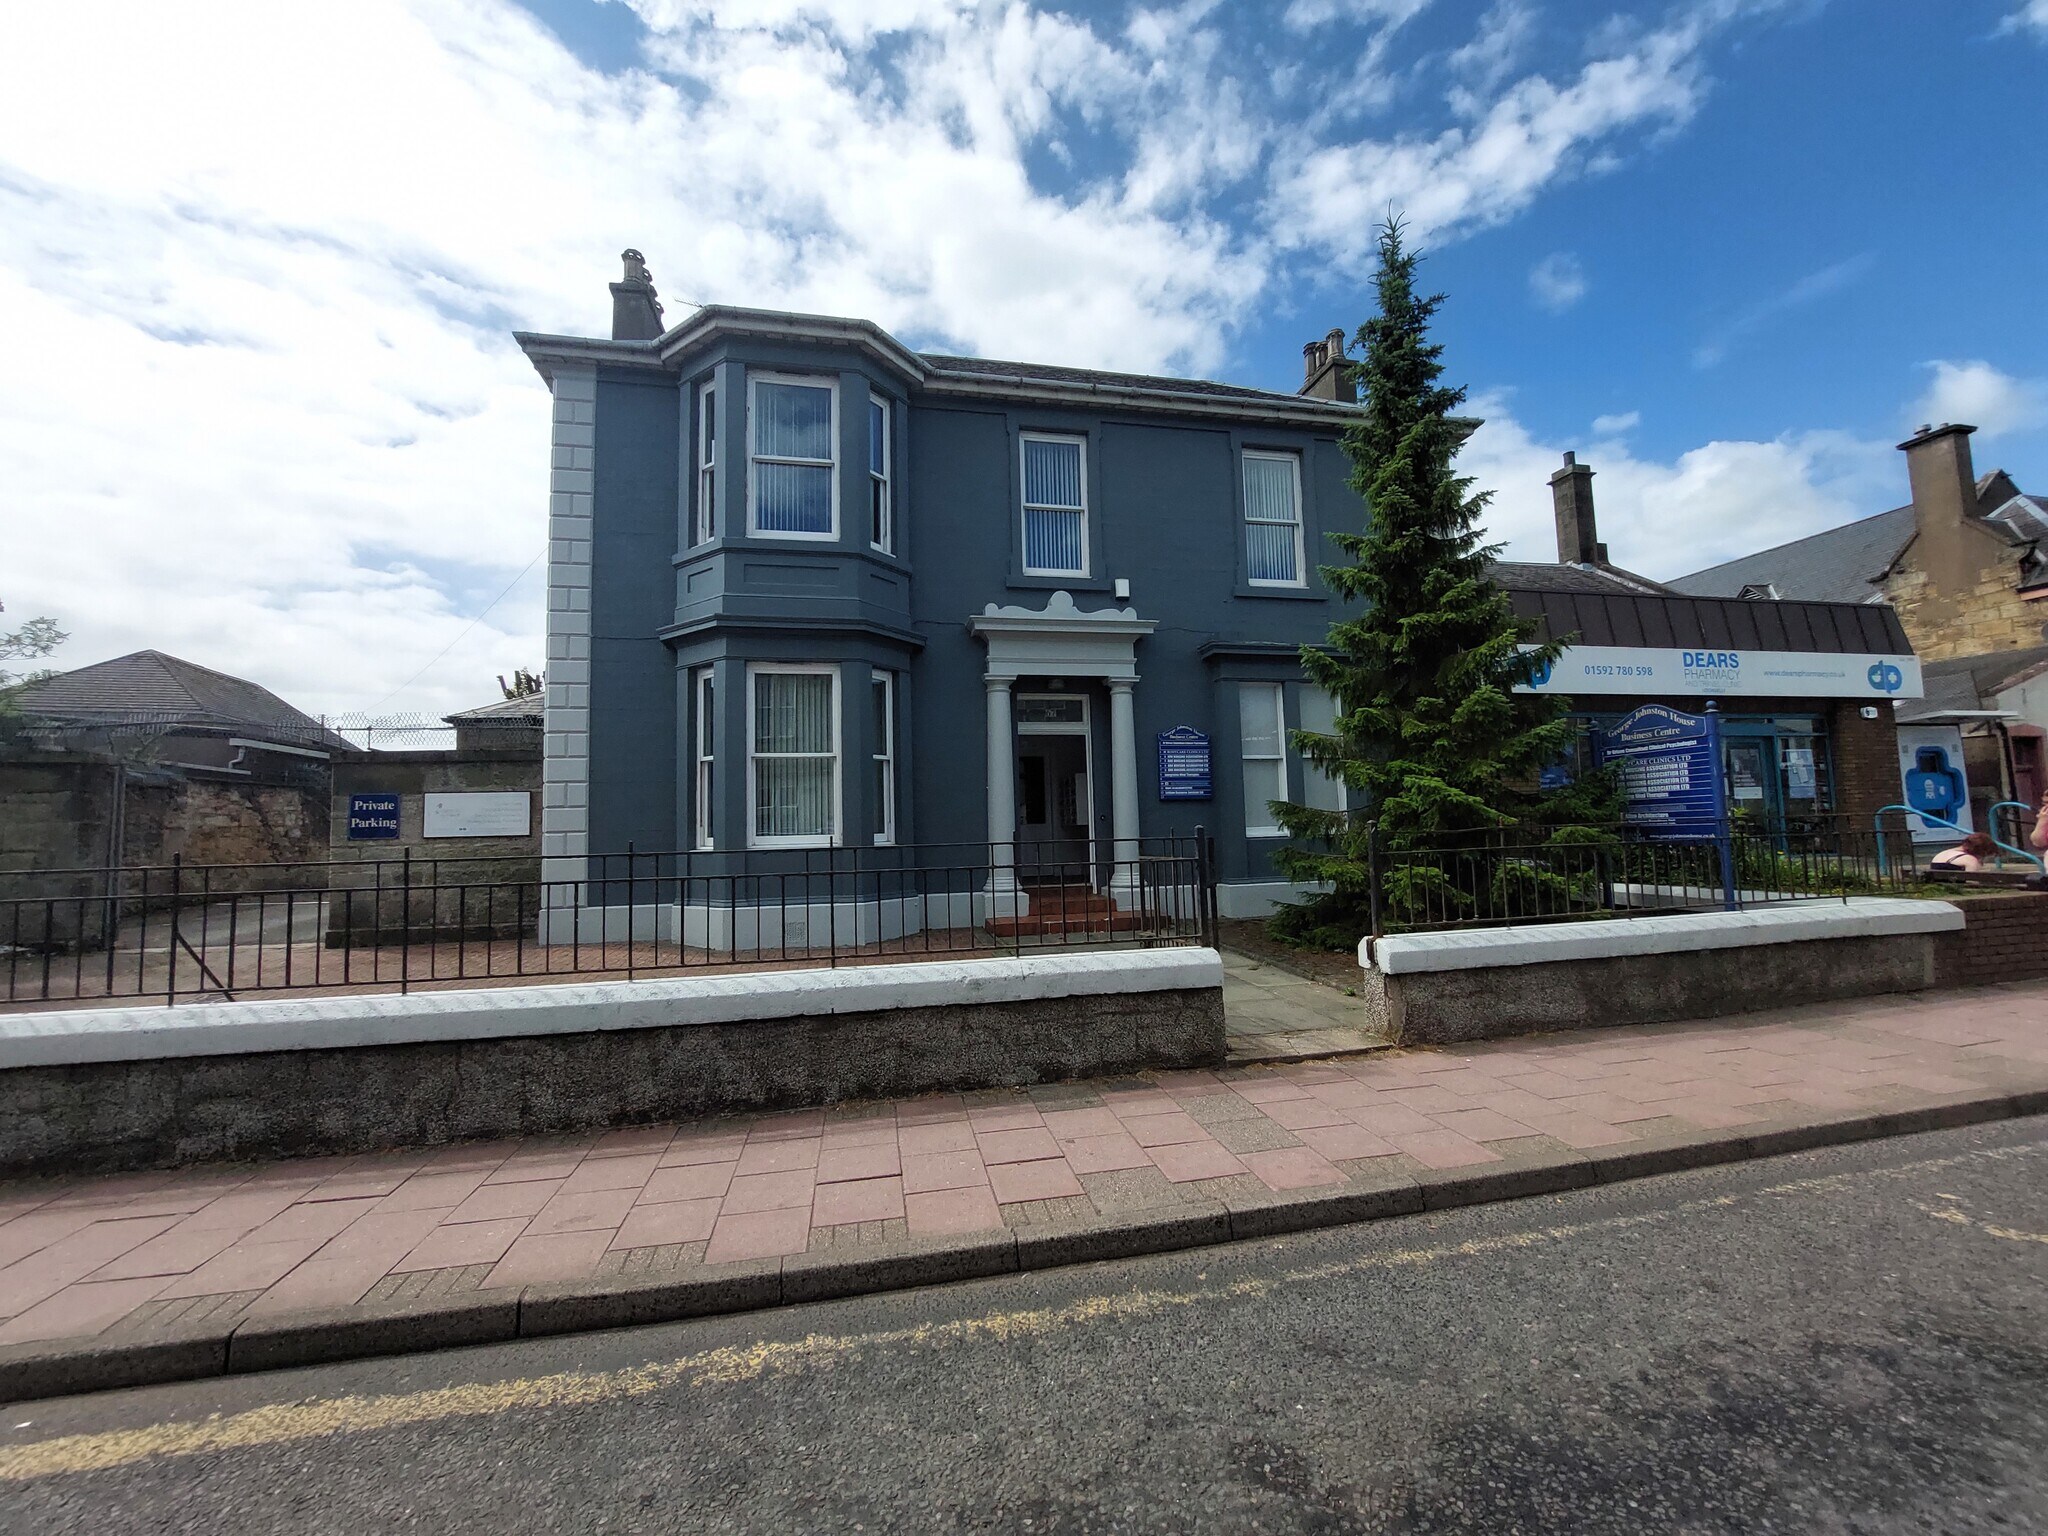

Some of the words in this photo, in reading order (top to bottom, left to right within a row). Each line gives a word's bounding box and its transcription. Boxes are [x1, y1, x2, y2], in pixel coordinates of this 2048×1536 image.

[1682, 652, 1740, 668] DEARS
[1584, 665, 1613, 676] 01592
[1616, 665, 1634, 676] 780
[1636, 666, 1653, 677] 598
[1684, 669, 1741, 680] PHARMACY
[1607, 718, 1633, 738] George
[1634, 708, 1668, 722] Johnston
[1669, 712, 1696, 726] House
[1621, 731, 1653, 741] Business
[1654, 728, 1681, 737] Centre
[1666, 740, 1697, 749] Psychologist
[1649, 756, 1676, 765] CLINICS
[354, 800, 395, 811] Private
[350, 818, 397, 829] Parking
